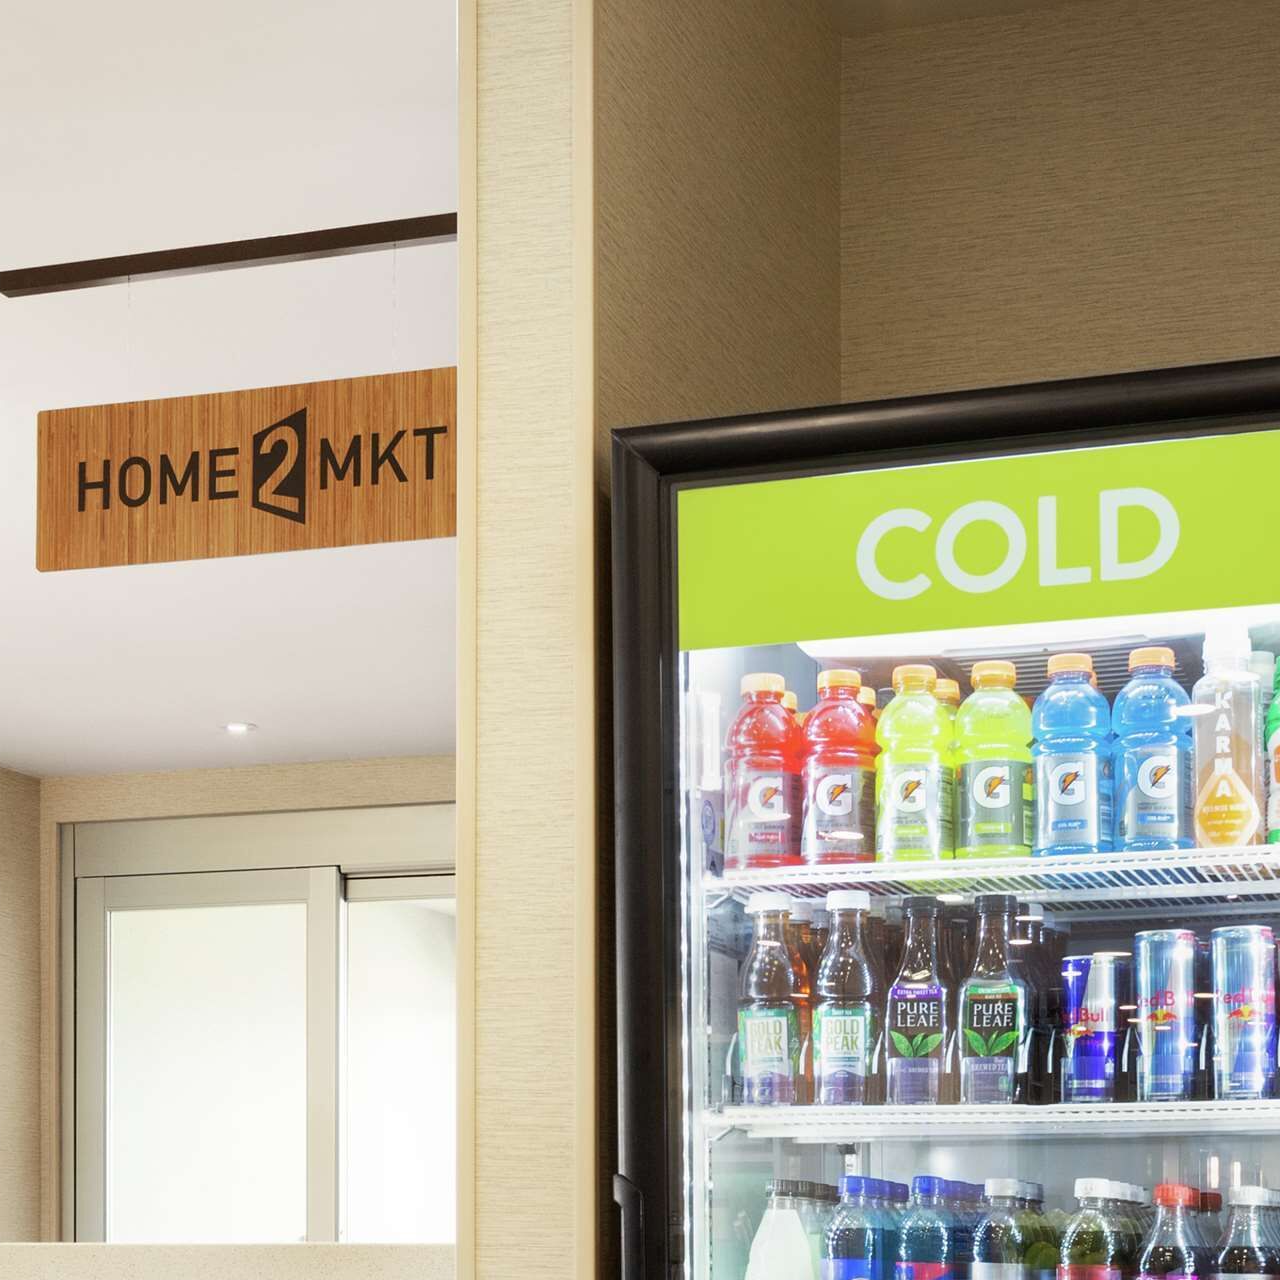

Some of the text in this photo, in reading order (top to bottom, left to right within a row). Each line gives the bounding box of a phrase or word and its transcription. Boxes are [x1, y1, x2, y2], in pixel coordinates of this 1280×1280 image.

[77, 446, 240, 513] HOME
[320, 425, 448, 490] MKT
[856, 488, 1181, 601] COLD
[897, 1001, 939, 1014] PURE
[973, 1002, 1013, 1016] PURE
